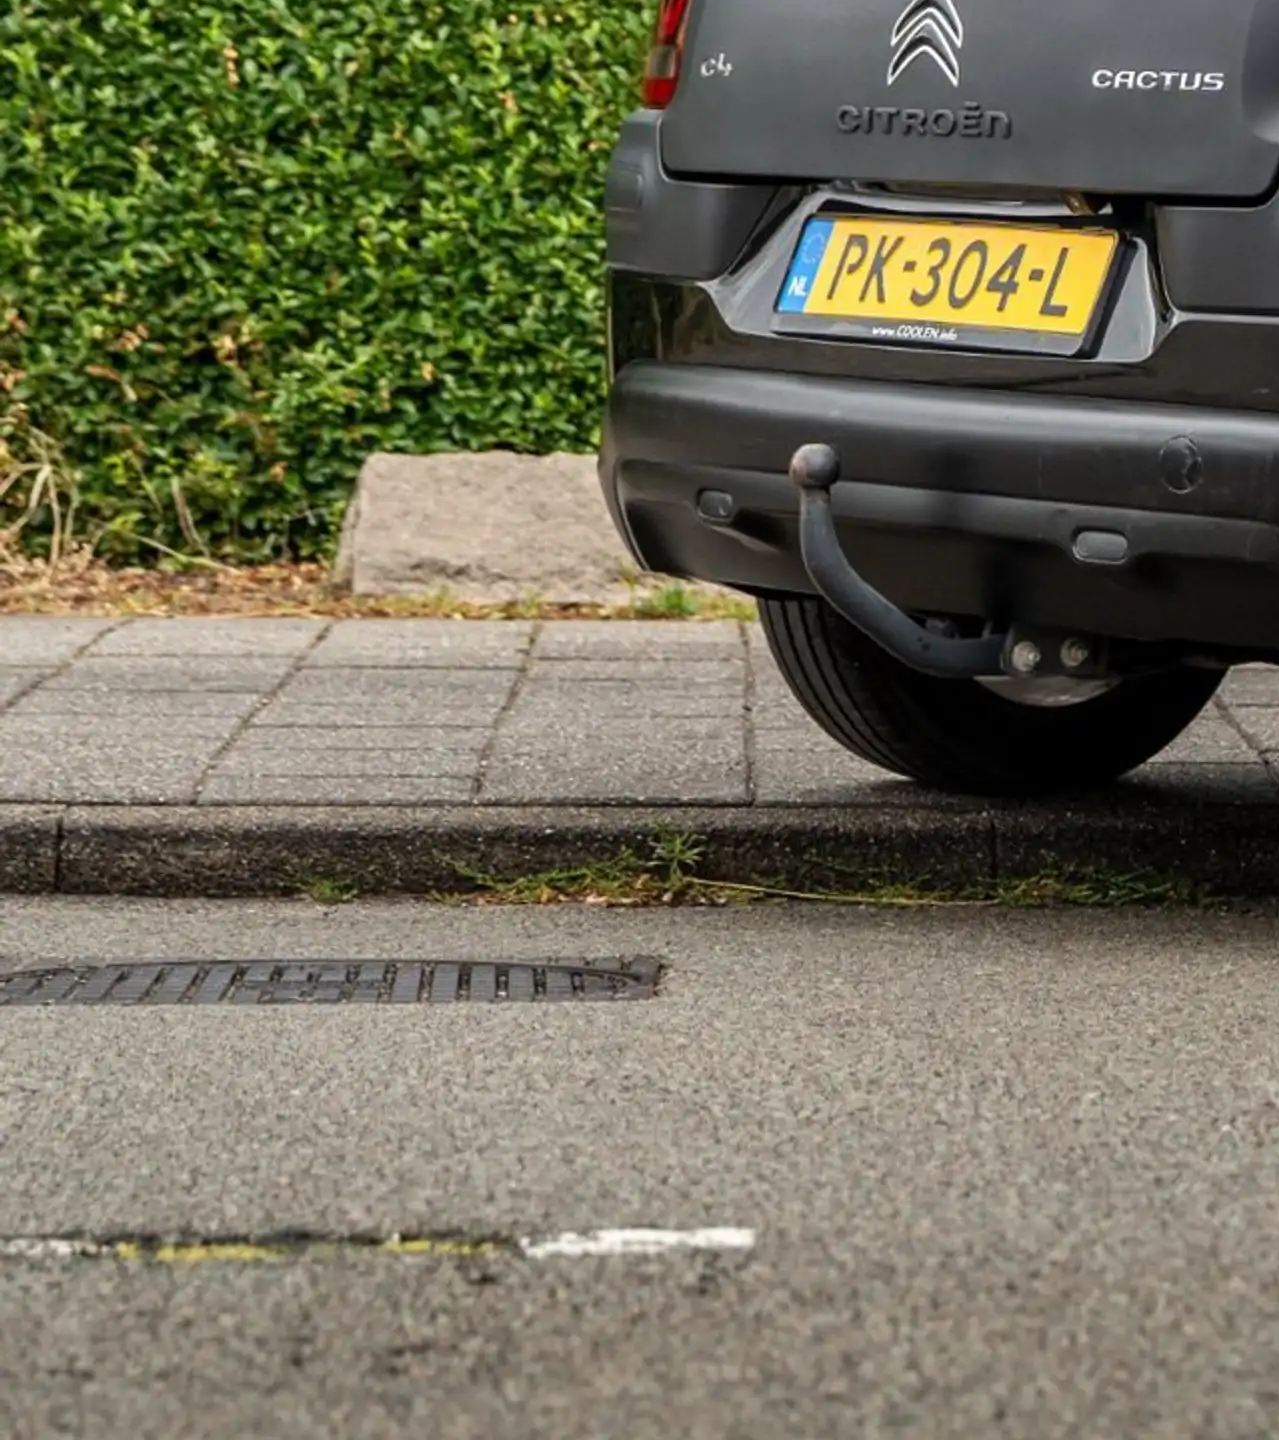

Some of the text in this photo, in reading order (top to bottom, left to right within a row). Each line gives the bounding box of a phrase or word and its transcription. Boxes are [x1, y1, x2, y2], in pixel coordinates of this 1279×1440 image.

[1091, 68, 1225, 91] CACTUS
[835, 101, 1012, 140] CITROËN
[788, 275, 807, 297] NL
[826, 233, 1070, 318] PK-304-L
